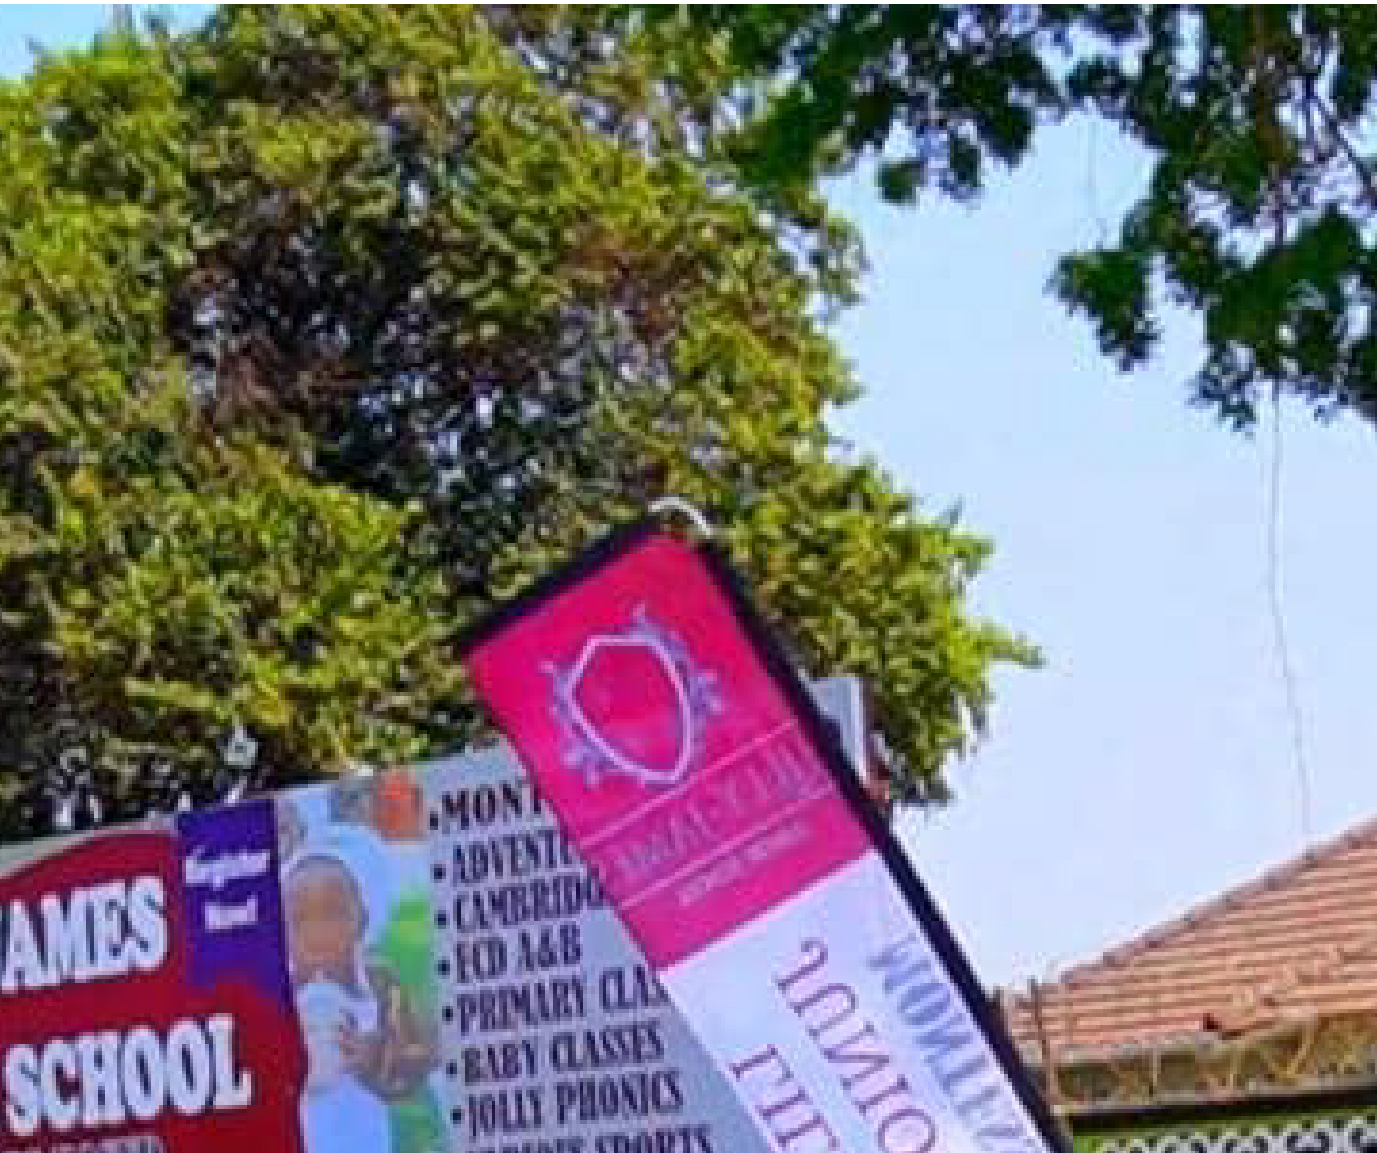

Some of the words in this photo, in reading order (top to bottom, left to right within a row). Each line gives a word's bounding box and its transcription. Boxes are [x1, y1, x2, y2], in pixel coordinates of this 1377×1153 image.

[454, 935, 508, 984] ECD
[457, 974, 586, 1036] PRIMARY
[2, 1012, 254, 1136] SCHOOL
[461, 1038, 538, 1087] BABY
[549, 1020, 665, 1074] CLASSES
[468, 1087, 542, 1143] JOLLY
[556, 1067, 683, 1128] PHONICS
